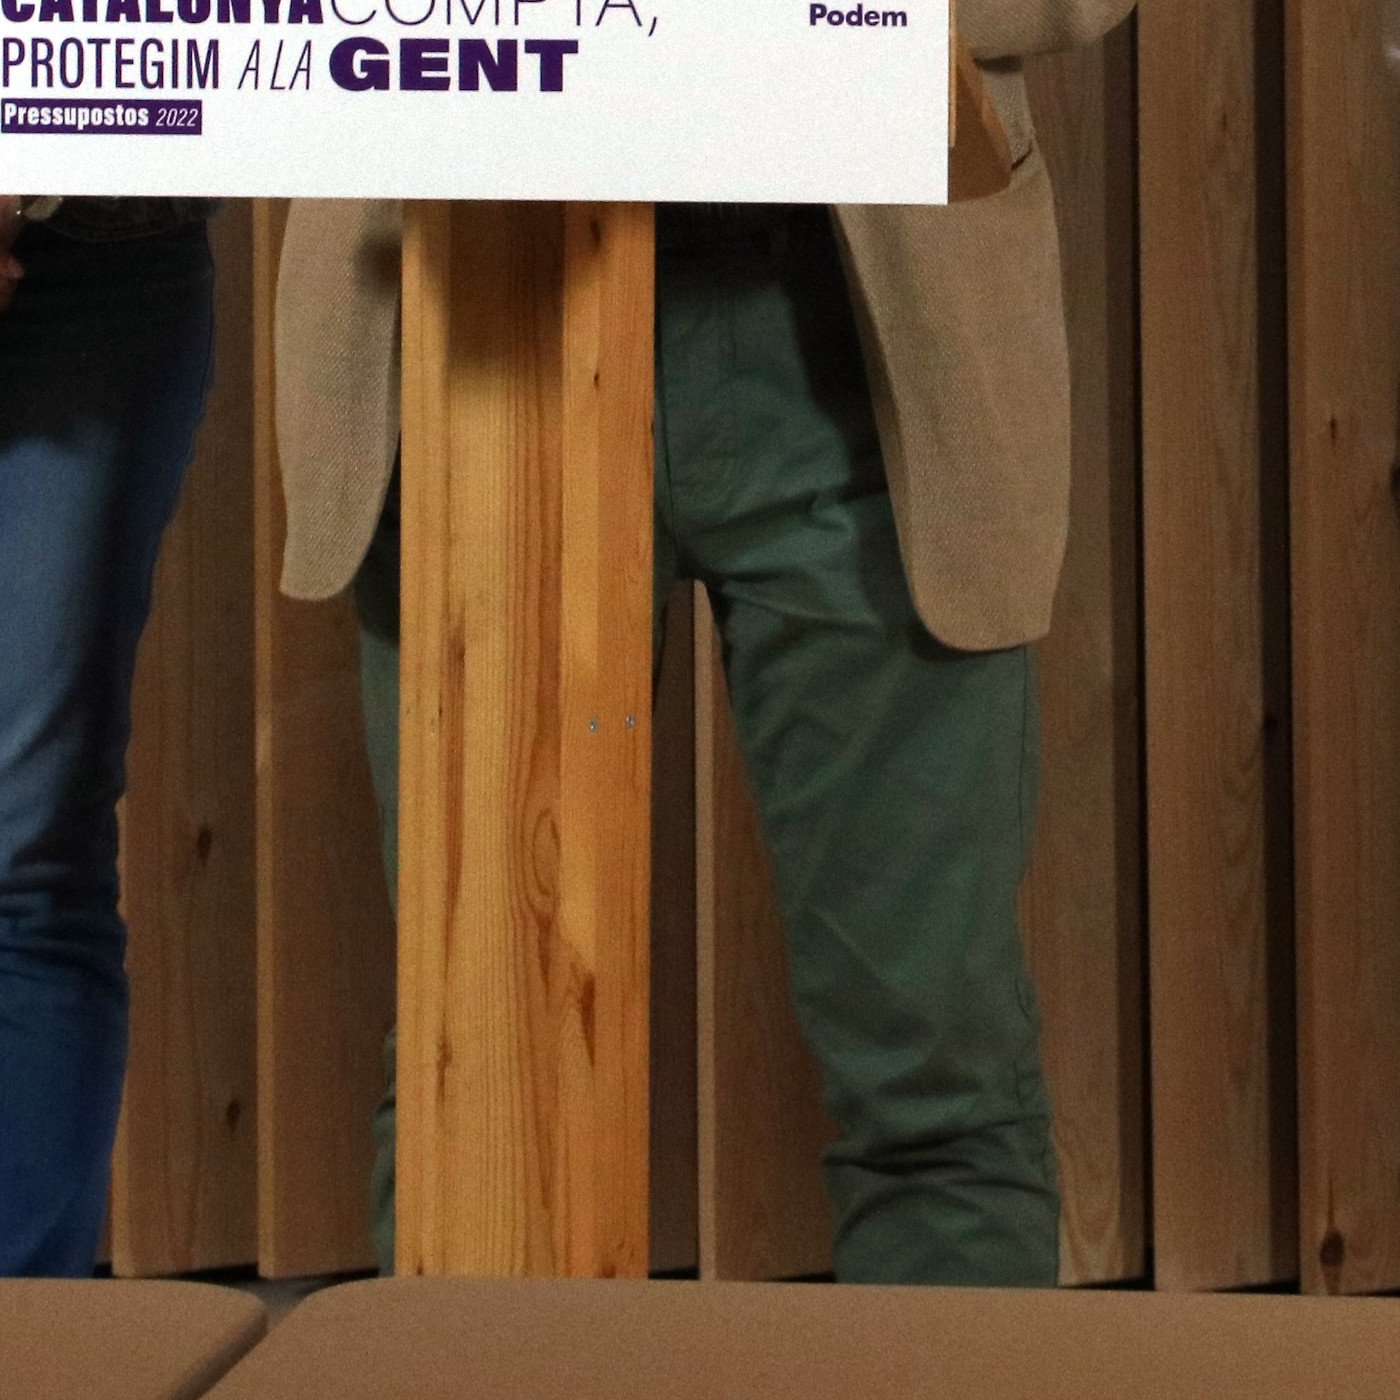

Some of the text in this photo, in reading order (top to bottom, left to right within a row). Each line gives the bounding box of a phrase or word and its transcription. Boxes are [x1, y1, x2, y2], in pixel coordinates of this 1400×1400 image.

[809, 3, 908, 27] Podem
[2, 36, 220, 90] PROTEGIM
[328, 36, 579, 92] GENT
[4, 102, 199, 131] Pressupostos 2022
